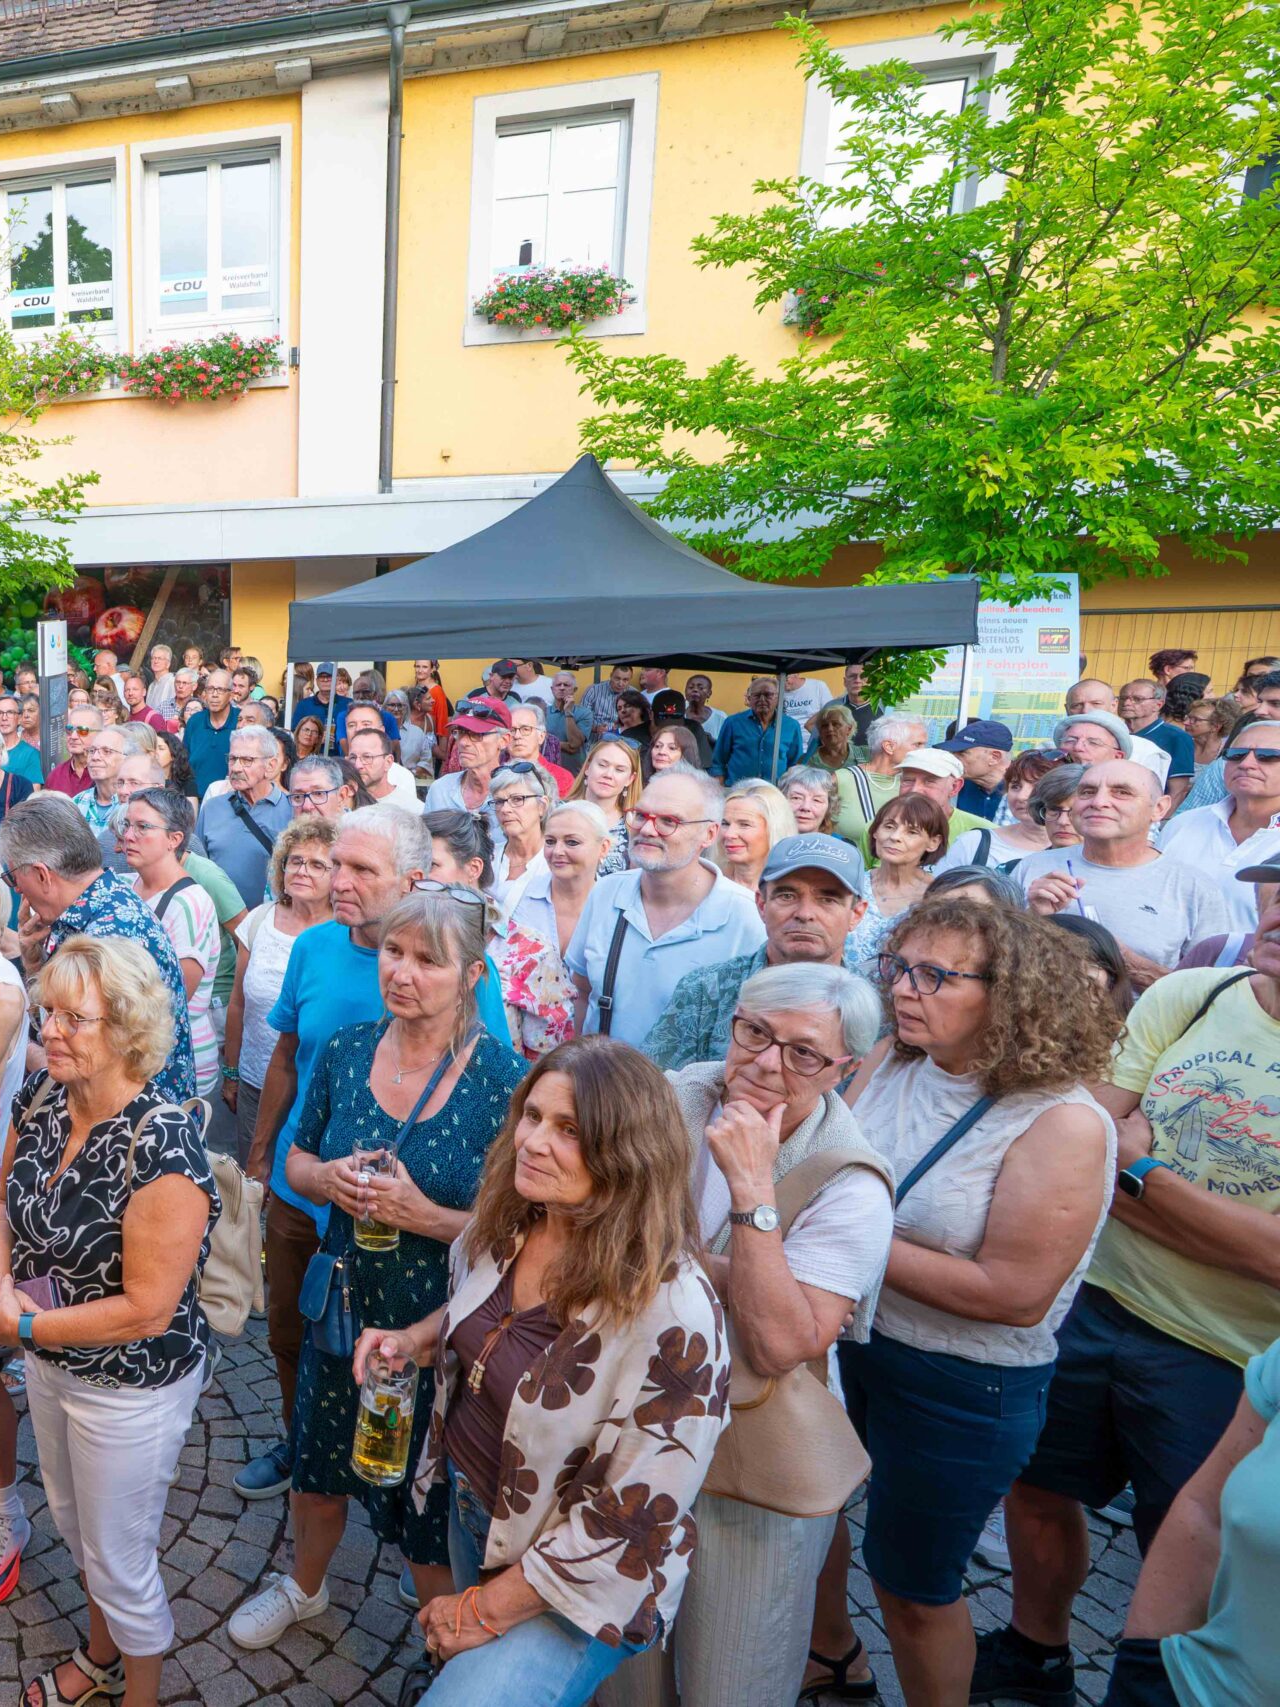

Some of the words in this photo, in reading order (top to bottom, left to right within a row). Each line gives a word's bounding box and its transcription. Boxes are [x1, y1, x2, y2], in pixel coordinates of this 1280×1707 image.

[222, 272, 269, 281] Kreisverband
[173, 280, 202, 292] CDU
[229, 280, 261, 289] Waldshut
[71, 288, 110, 297] Kreisverband
[23, 296, 50, 307] CDU
[76, 296, 104, 304] Waldshut
[1006, 646, 1024, 654] WTV
[986, 659, 1049, 670] Fahrplan
[1158, 1050, 1256, 1084] TROPICAL
